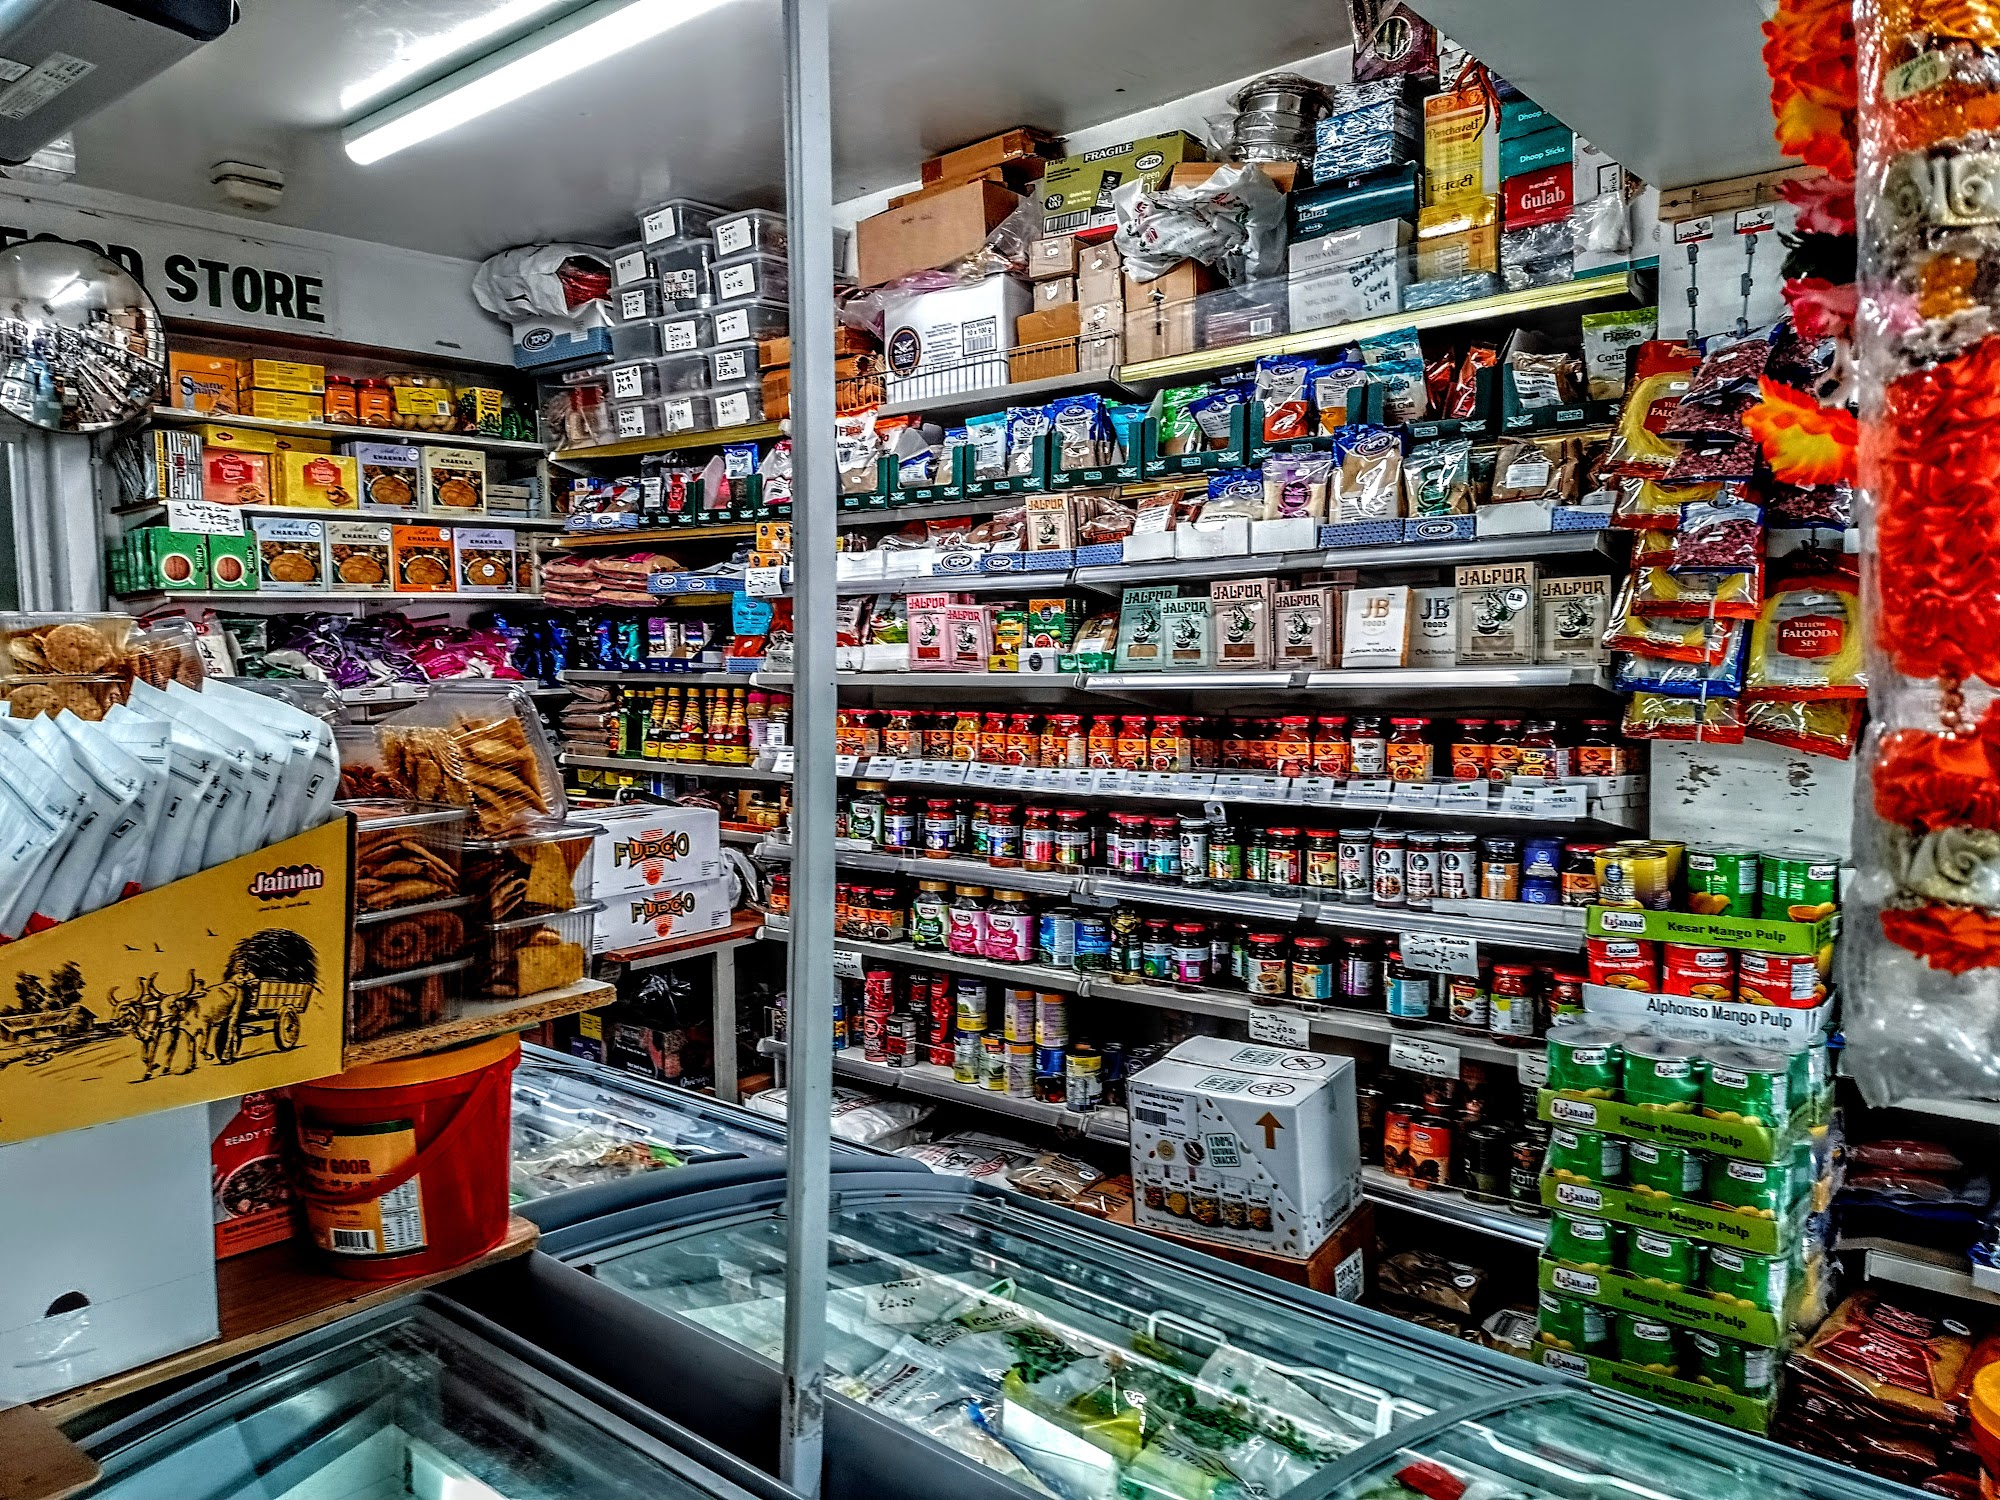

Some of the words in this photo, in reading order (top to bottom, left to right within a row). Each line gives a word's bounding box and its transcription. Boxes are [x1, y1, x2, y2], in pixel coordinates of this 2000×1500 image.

[1518, 110, 1542, 122] Dhoop
[1085, 144, 1133, 162] FRAGILE
[1519, 151, 1545, 163] Dhoop
[1546, 146, 1566, 158] Sticks
[1139, 157, 1160, 167] Grace
[1520, 187, 1566, 210] Gulab
[164, 254, 325, 323] STORE
[1028, 498, 1064, 510] JALPUR
[270, 529, 309, 537] KHAKHRA
[1459, 568, 1527, 586] JALPUR
[1125, 589, 1173, 605] JALPUR
[1214, 584, 1263, 600] JALPUR
[1542, 580, 1606, 597] JALPUR
[909, 597, 945, 609] JALPUR
[1163, 601, 1208, 614] JALPUR
[1276, 594, 1320, 608] JALPUR
[1361, 597, 1390, 619] JB
[1419, 597, 1450, 619] JB
[946, 610, 981, 623] JALPUR
[1782, 628, 1839, 639] FALOODA
[1801, 639, 1819, 647] SEV
[614, 833, 690, 868] FUDCO
[250, 868, 321, 894] Jaimin
[631, 892, 695, 923] FUDCO
[1668, 921, 1706, 934] Kesar
[1708, 925, 1752, 939] Mango
[1756, 928, 1786, 943] Pulp
[1647, 998, 1708, 1019] Alphonso
[1711, 1006, 1757, 1027] Mango
[1761, 1011, 1793, 1029] Pulp
[224, 1133, 264, 1147] READY
[1619, 1116, 1658, 1133] Kesar
[1660, 1123, 1708, 1143] Mango
[1710, 1130, 1743, 1148] Pulp
[1208, 1136, 1233, 1147] 100%
[330, 1159, 371, 1175] GOOR
[1212, 1155, 1238, 1165] SNACKS
[1625, 1202, 1666, 1219] Kesar
[1668, 1209, 1713, 1230] Mango
[1717, 1221, 1750, 1239] Pulp
[1622, 1288, 1662, 1306] Kesar
[1664, 1298, 1711, 1319] Mango
[1715, 1311, 1747, 1330] Pulp
[1652, 1381, 1701, 1404] Mango
[1703, 1396, 1736, 1415] Pulp
